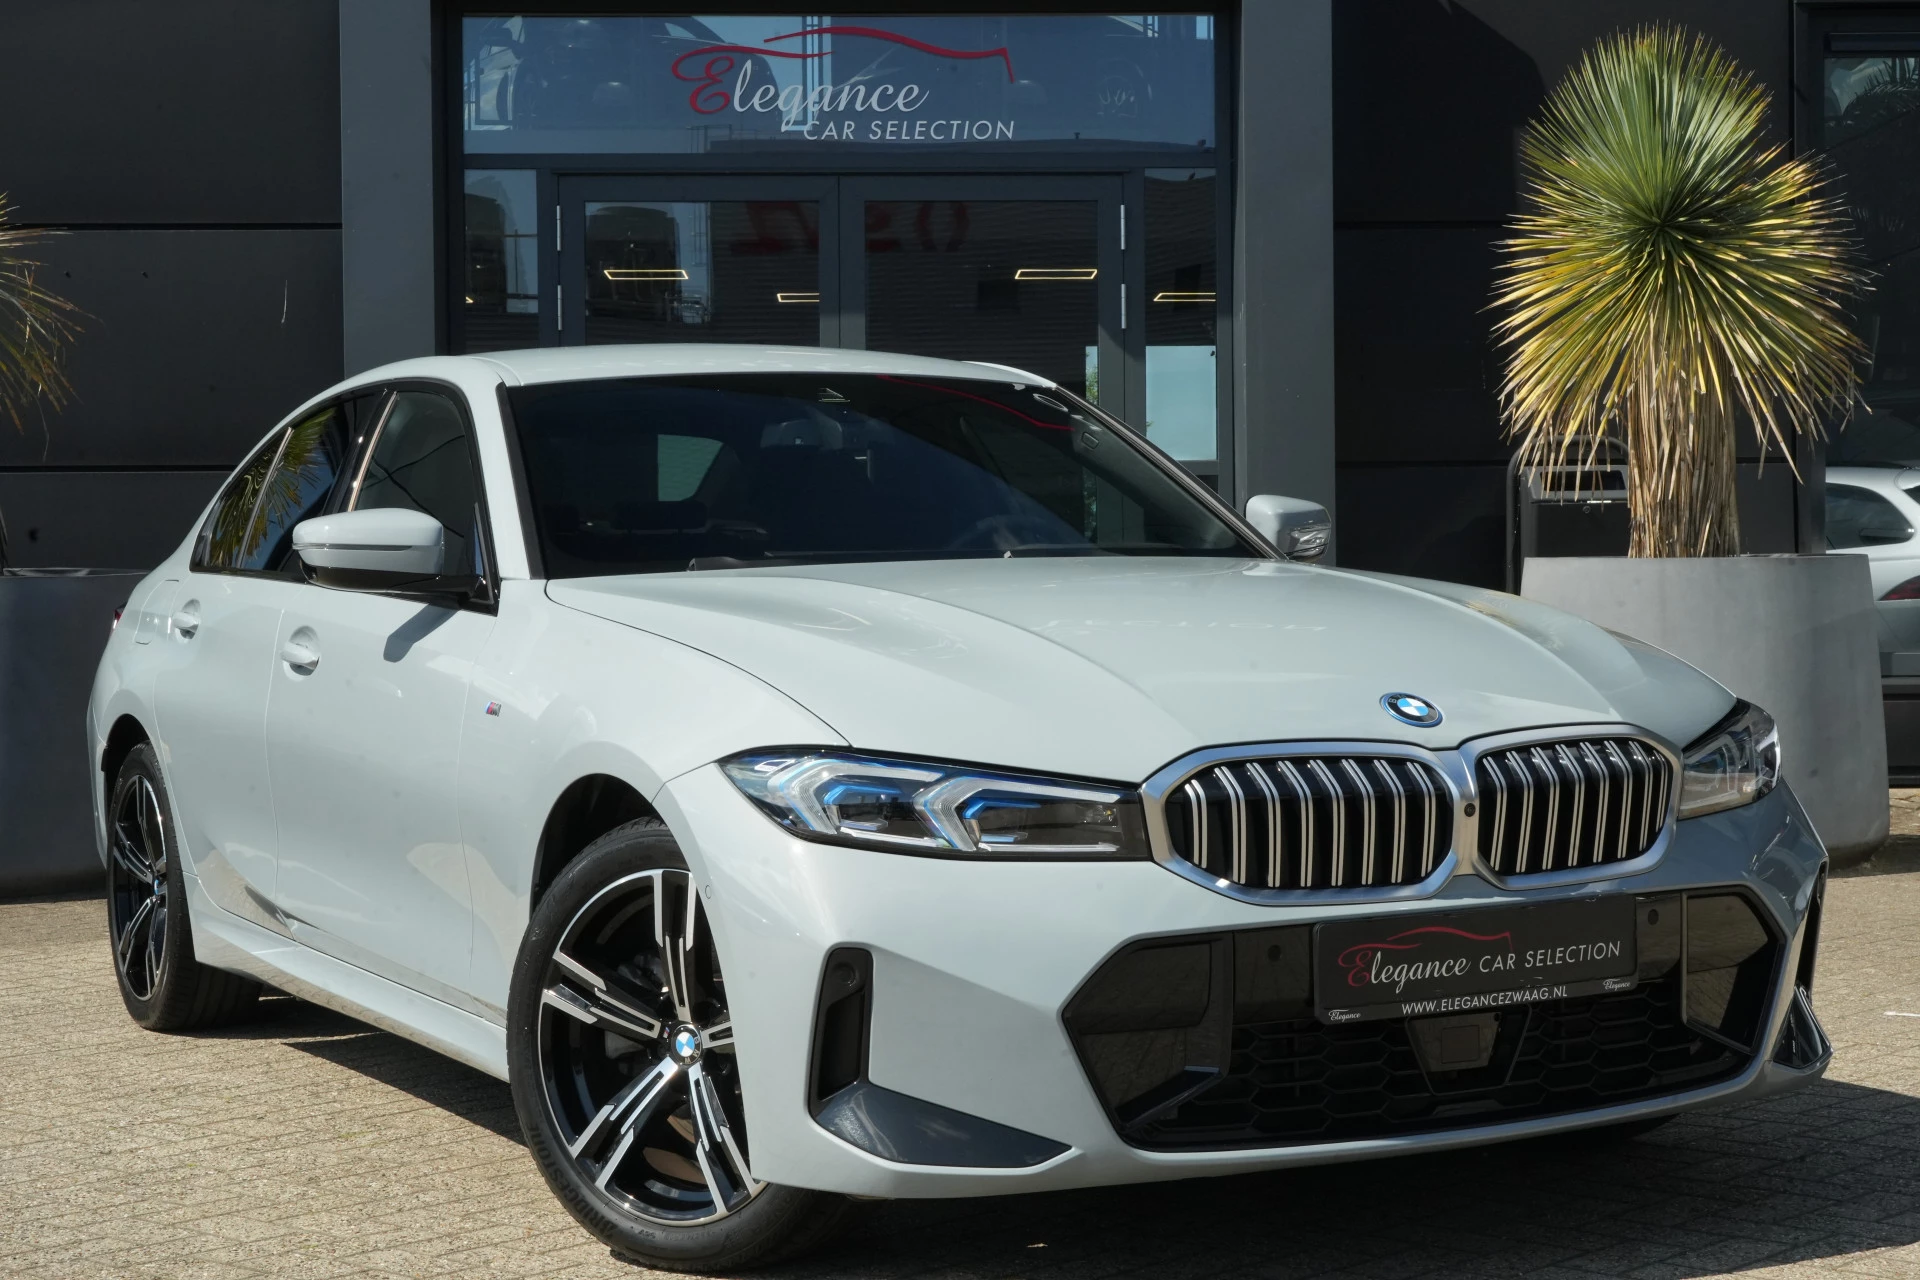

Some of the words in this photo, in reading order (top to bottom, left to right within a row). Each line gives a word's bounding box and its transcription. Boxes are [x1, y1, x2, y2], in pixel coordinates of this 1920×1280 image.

[672, 46, 930, 132] Elegance
[803, 120, 856, 141] CAR
[869, 120, 1015, 141] SELECTION
[1338, 943, 1471, 993] Elegance
[1479, 953, 1517, 973] CAR
[1524, 940, 1621, 968] SELECTION
[1401, 985, 1568, 1015] WWW.ELEGANCEZWAAG.NL
[1328, 1009, 1361, 1022] Elegance
